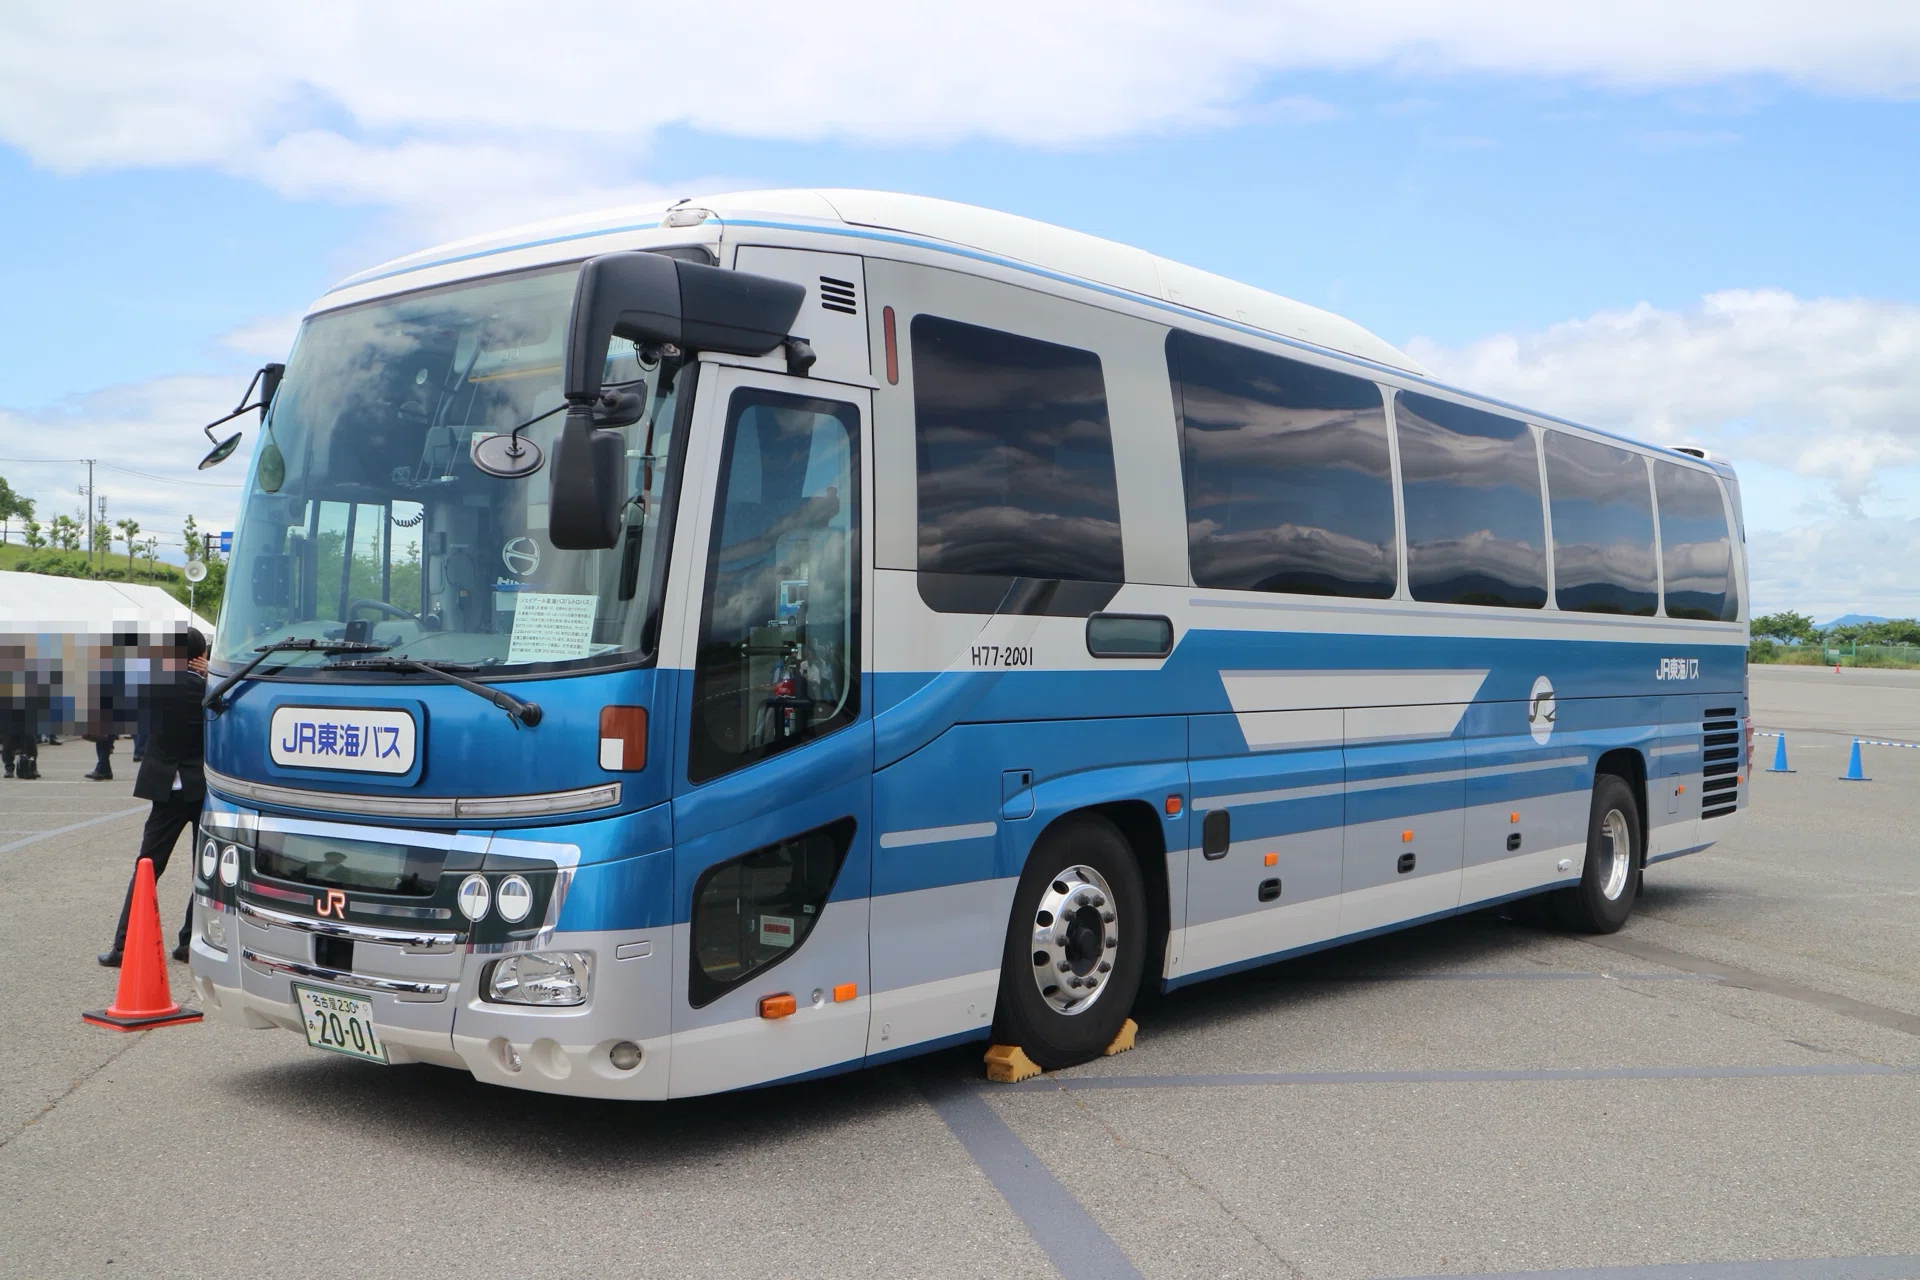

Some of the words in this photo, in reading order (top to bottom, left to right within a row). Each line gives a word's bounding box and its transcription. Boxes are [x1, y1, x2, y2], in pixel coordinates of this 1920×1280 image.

[971, 646, 1033, 666] H77-2001
[1656, 657, 1700, 681] JR東海バス
[282, 722, 401, 760] JR東海バス
[316, 889, 346, 920] JR
[315, 1009, 378, 1056] 20-01
